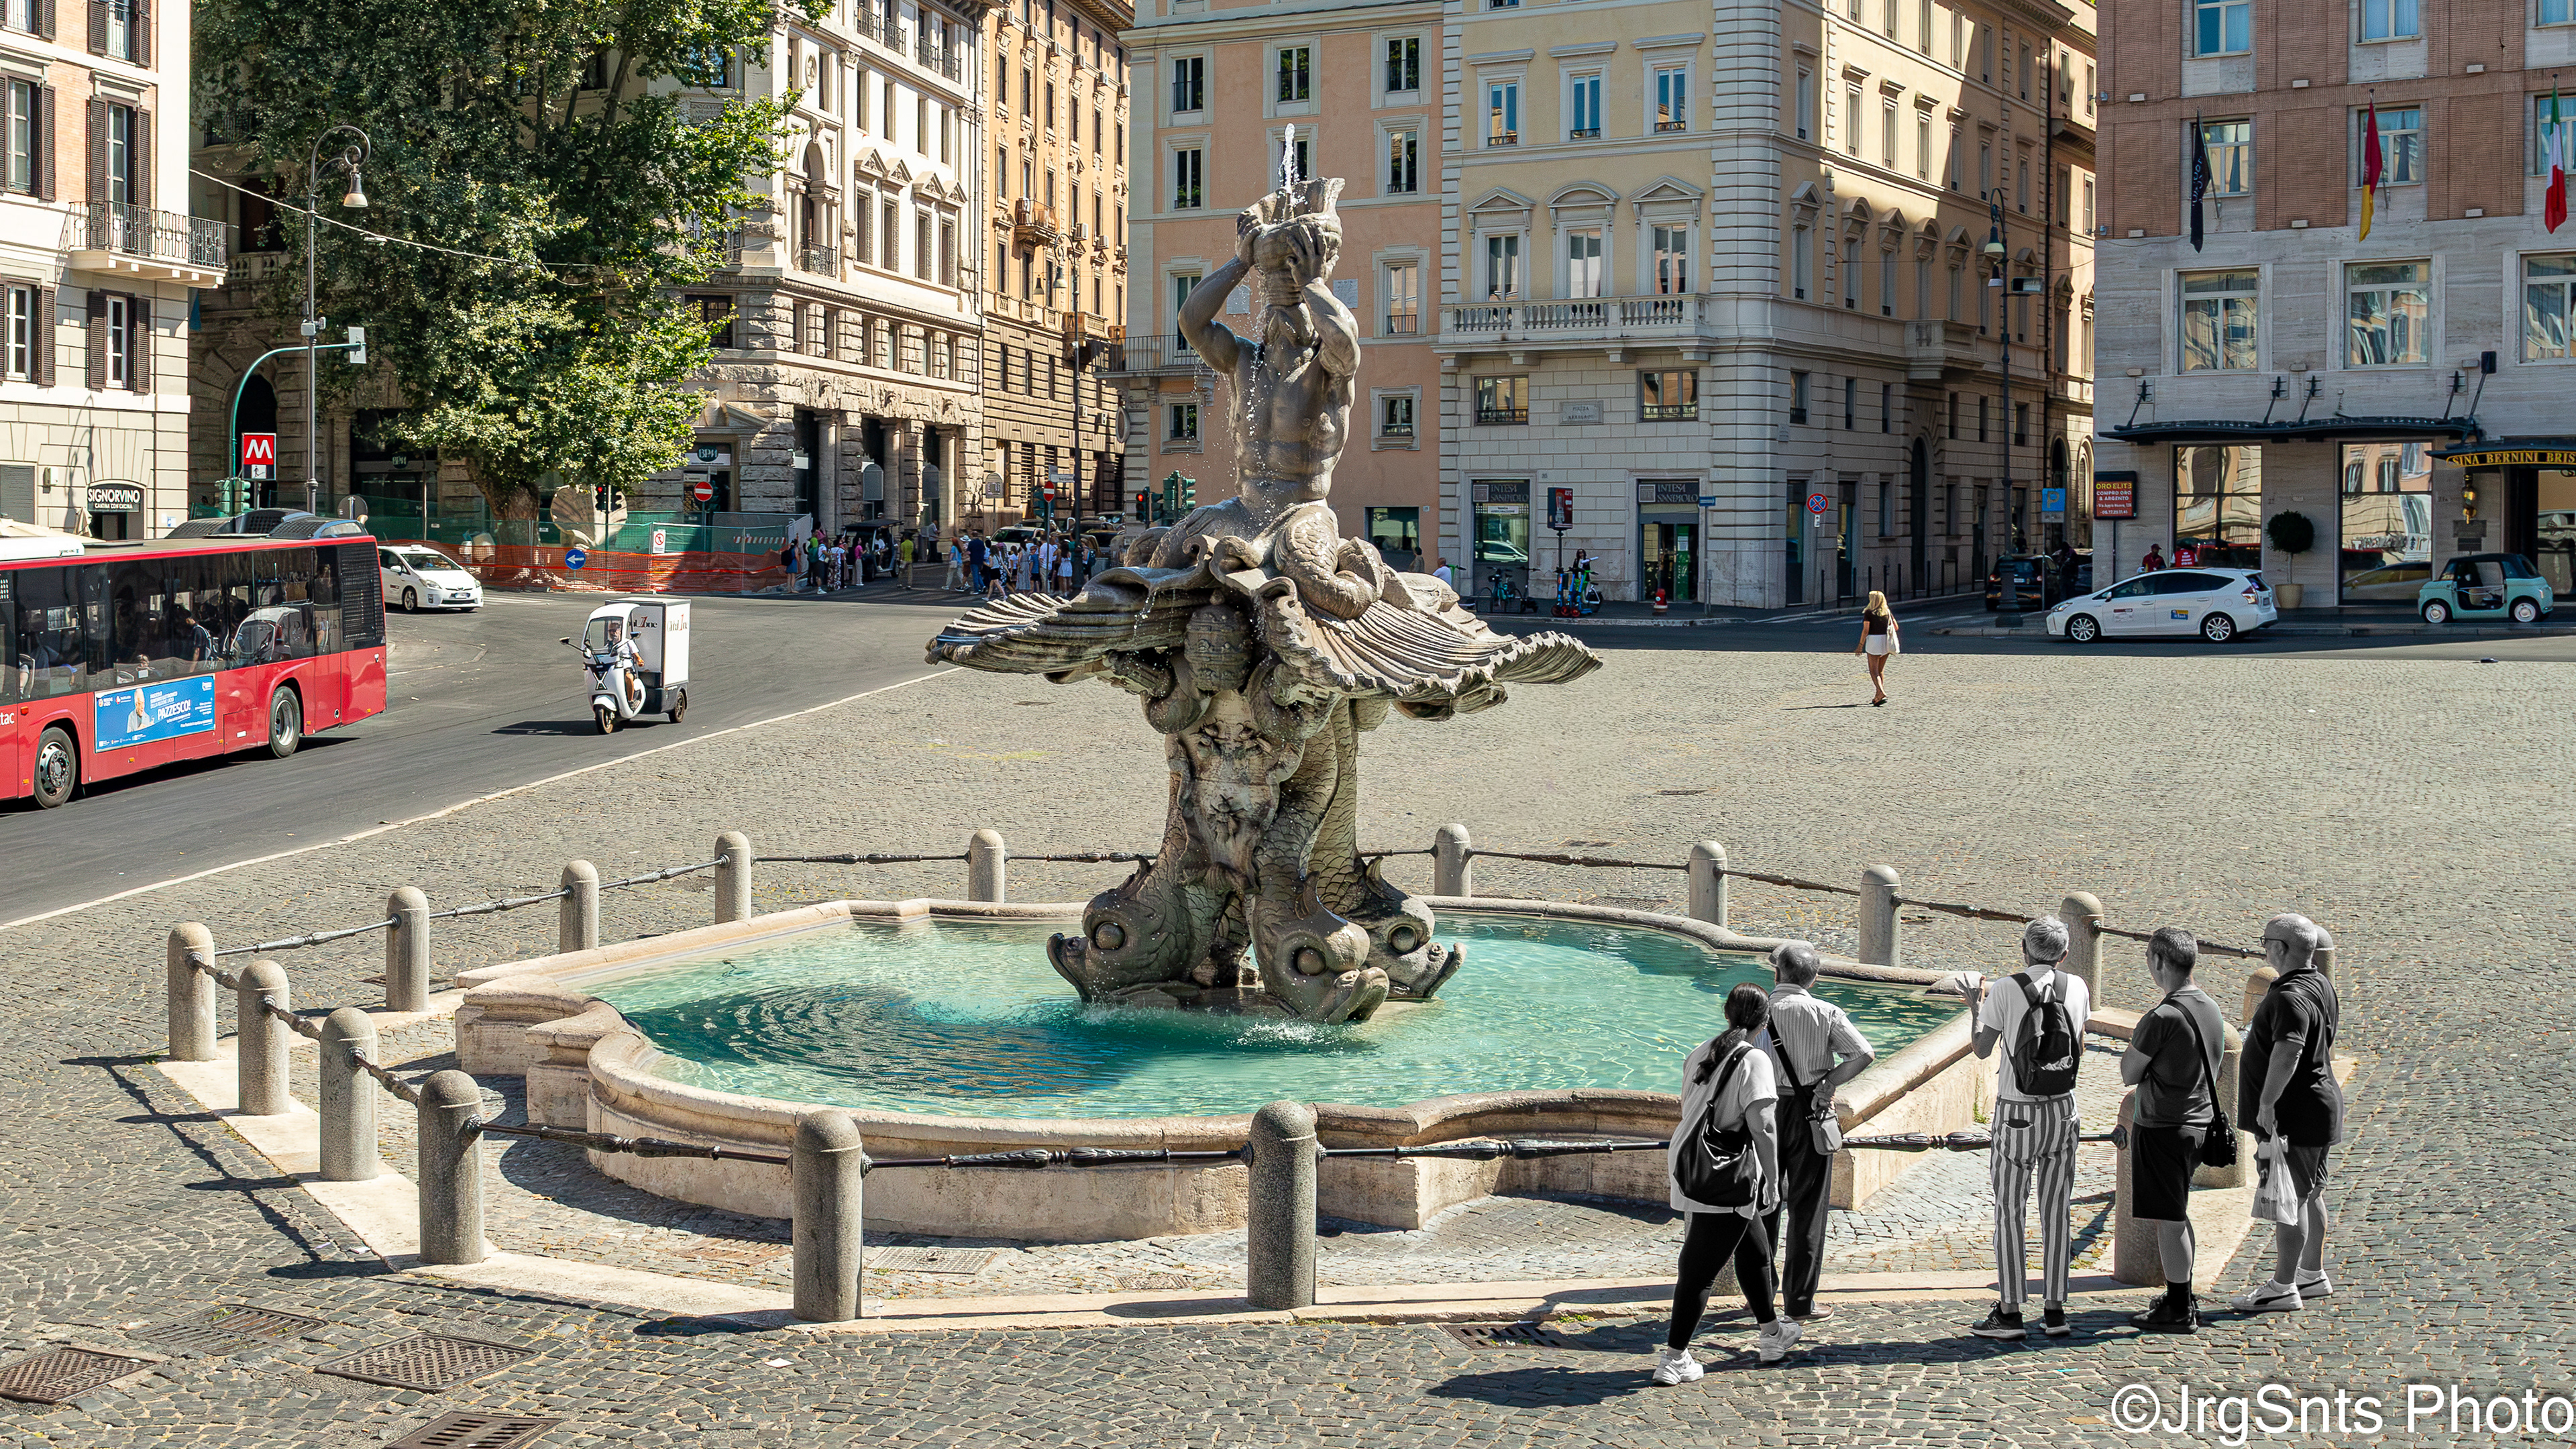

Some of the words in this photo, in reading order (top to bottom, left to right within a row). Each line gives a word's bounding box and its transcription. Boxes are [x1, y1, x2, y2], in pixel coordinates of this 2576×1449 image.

[246, 439, 273, 459] M
[2452, 455, 2479, 466] SINA
[2486, 452, 2538, 464] BERNINI
[2546, 452, 2576, 463] BRIS
[1491, 484, 1517, 492] INTESA
[1657, 484, 1686, 492] INTESA
[88, 488, 141, 503] SIGNORVINO
[2047, 490, 2059, 508] P
[157, 699, 191, 720] PAZZESCO!
[0, 712, 15, 726] tac
